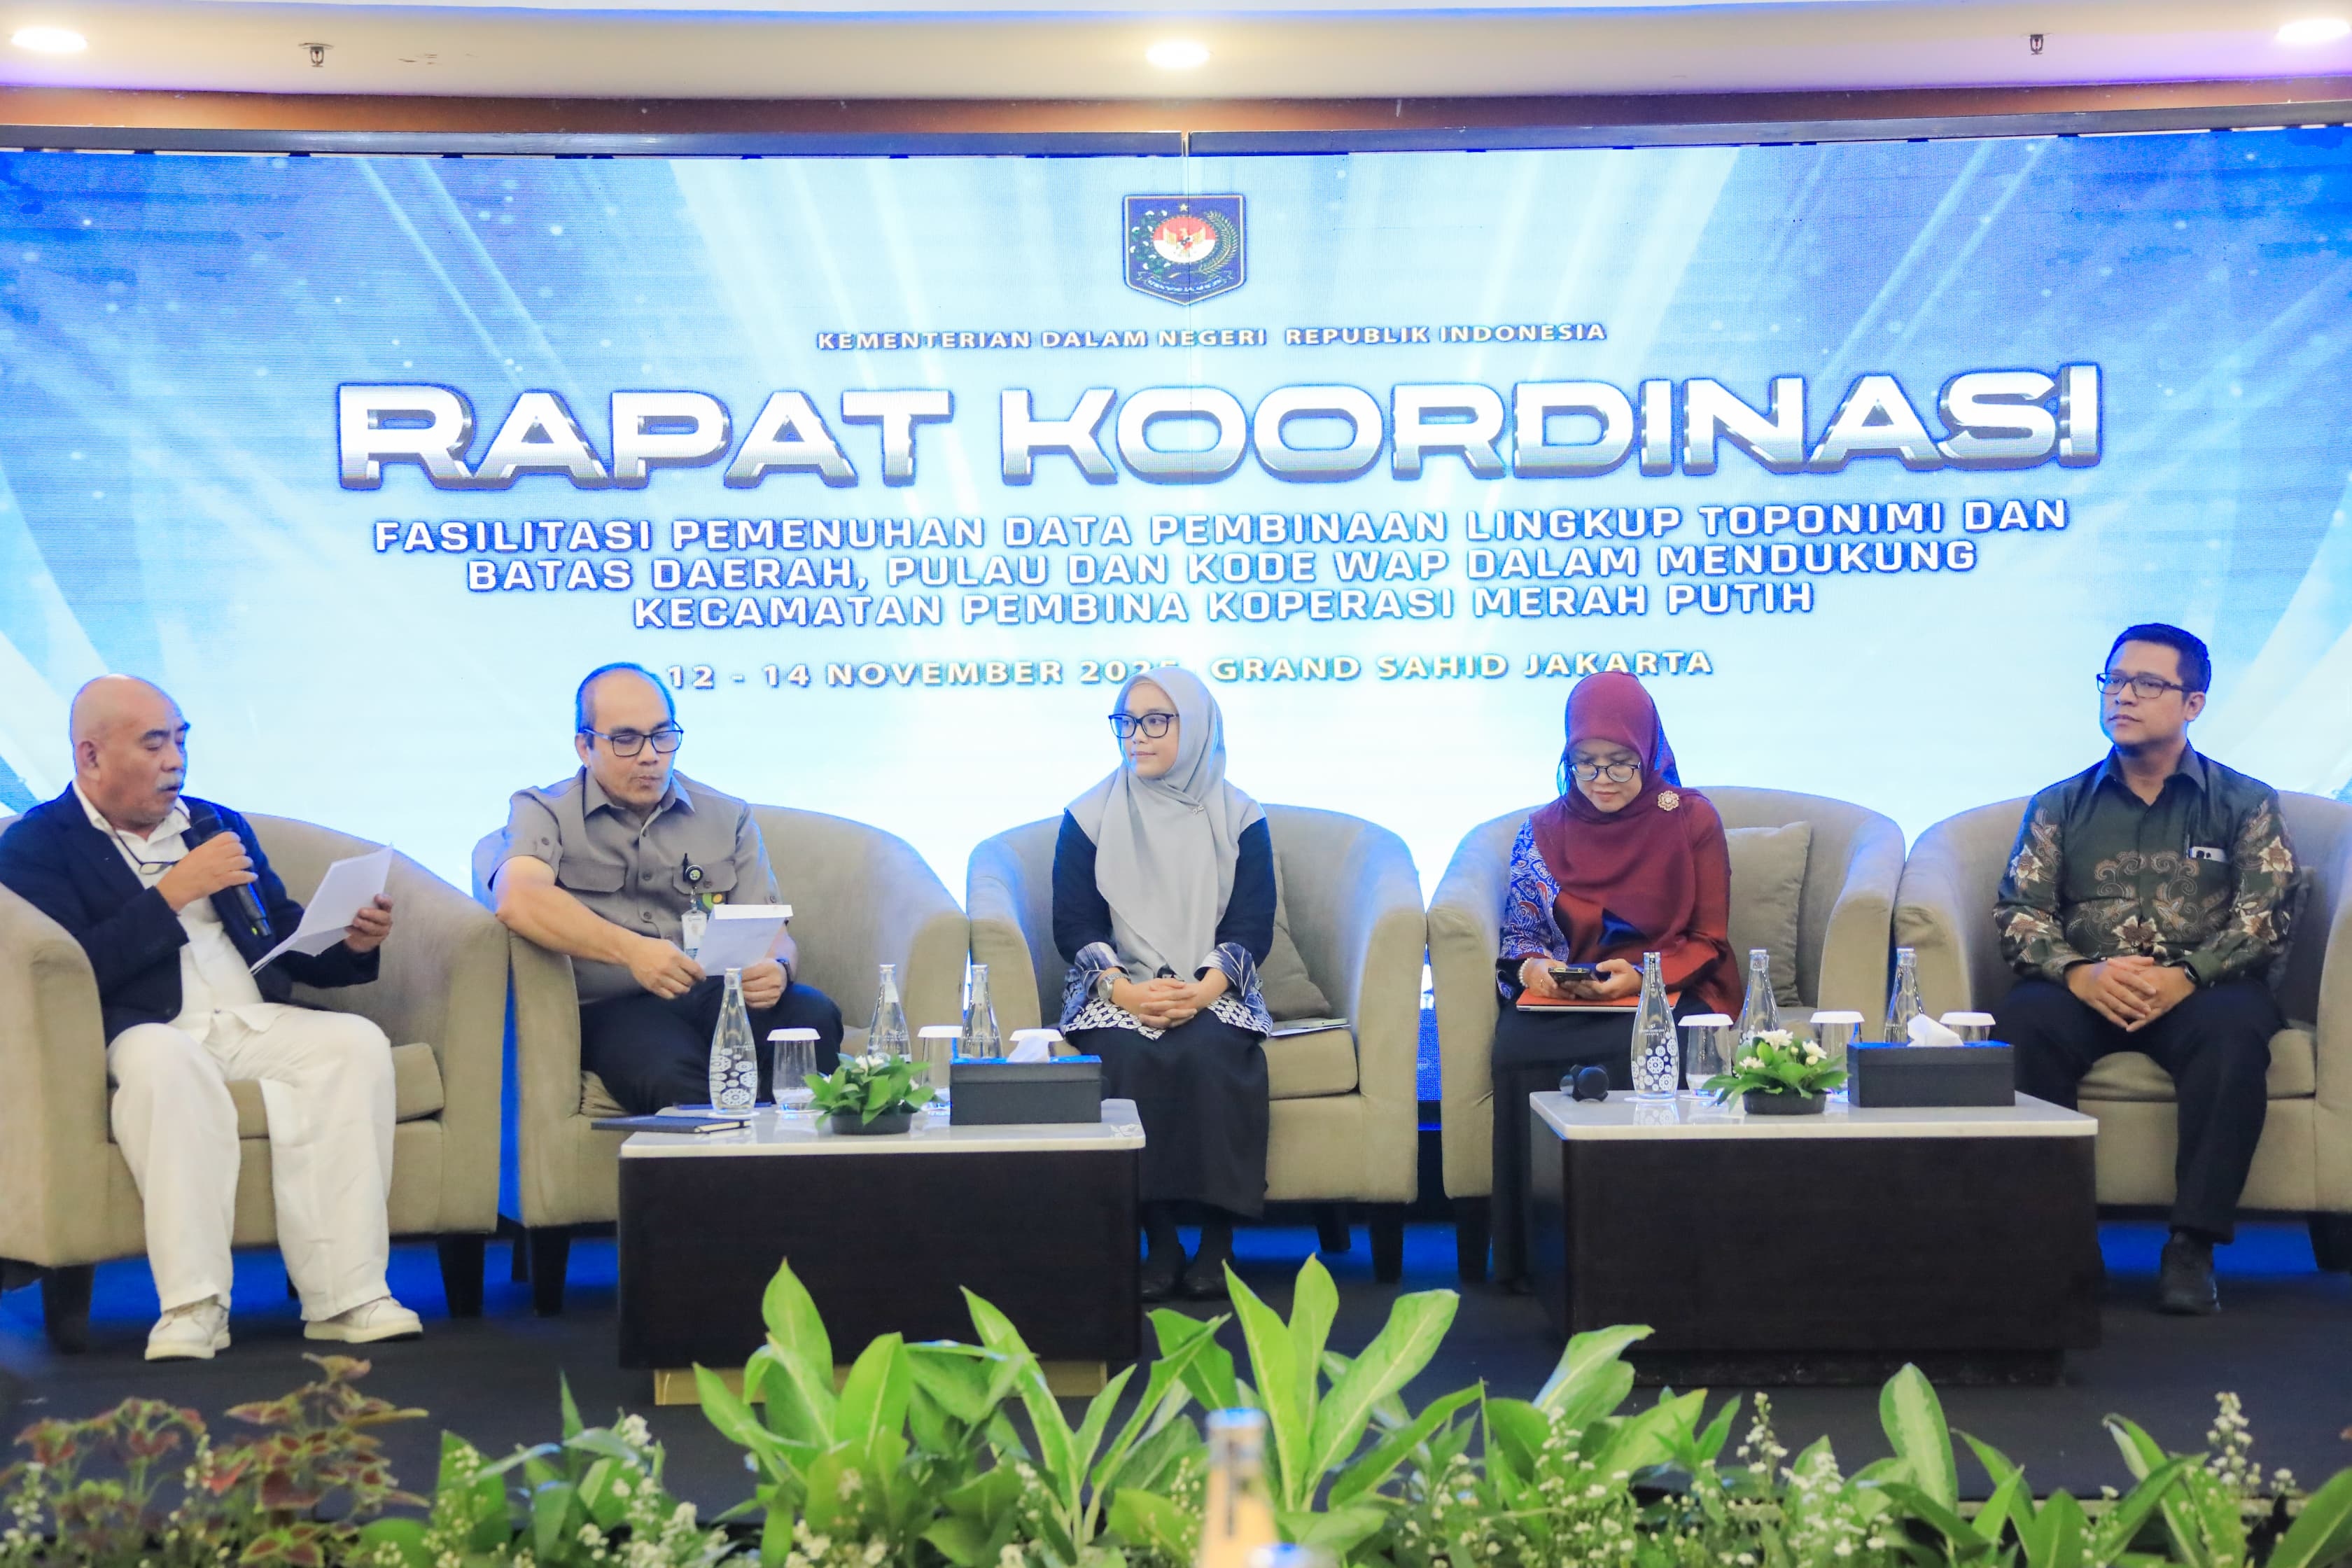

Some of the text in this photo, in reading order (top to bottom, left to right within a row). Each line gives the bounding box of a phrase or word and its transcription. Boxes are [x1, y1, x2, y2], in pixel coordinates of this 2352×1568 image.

[818, 323, 1606, 349] KEMENTERIAN DALAM NEGERI REPUBLIK INDONESIA
[340, 364, 2101, 489] RAPAT KOORDINASI
[374, 499, 2067, 552] FASILITASI PEMENUHAN DATA PEMBINAAN LINGKUP TOPONIMI DAN
[468, 540, 1977, 591] BATAS DAERAH, PULAU DAN KODE WAP DALAM MENDUKUNG
[634, 582, 1814, 629] KECAMATAN PEMBINA KOPERASI MERAH PUTIH
[667, 665, 715, 690] 12
[764, 664, 811, 688] 14
[827, 659, 1063, 688] NOVEMBER
[1080, 660, 1179, 684] 202
[1210, 656, 1360, 682] GRAND
[1378, 653, 1508, 680] SAHID
[1523, 651, 1713, 678] JAKARTA
